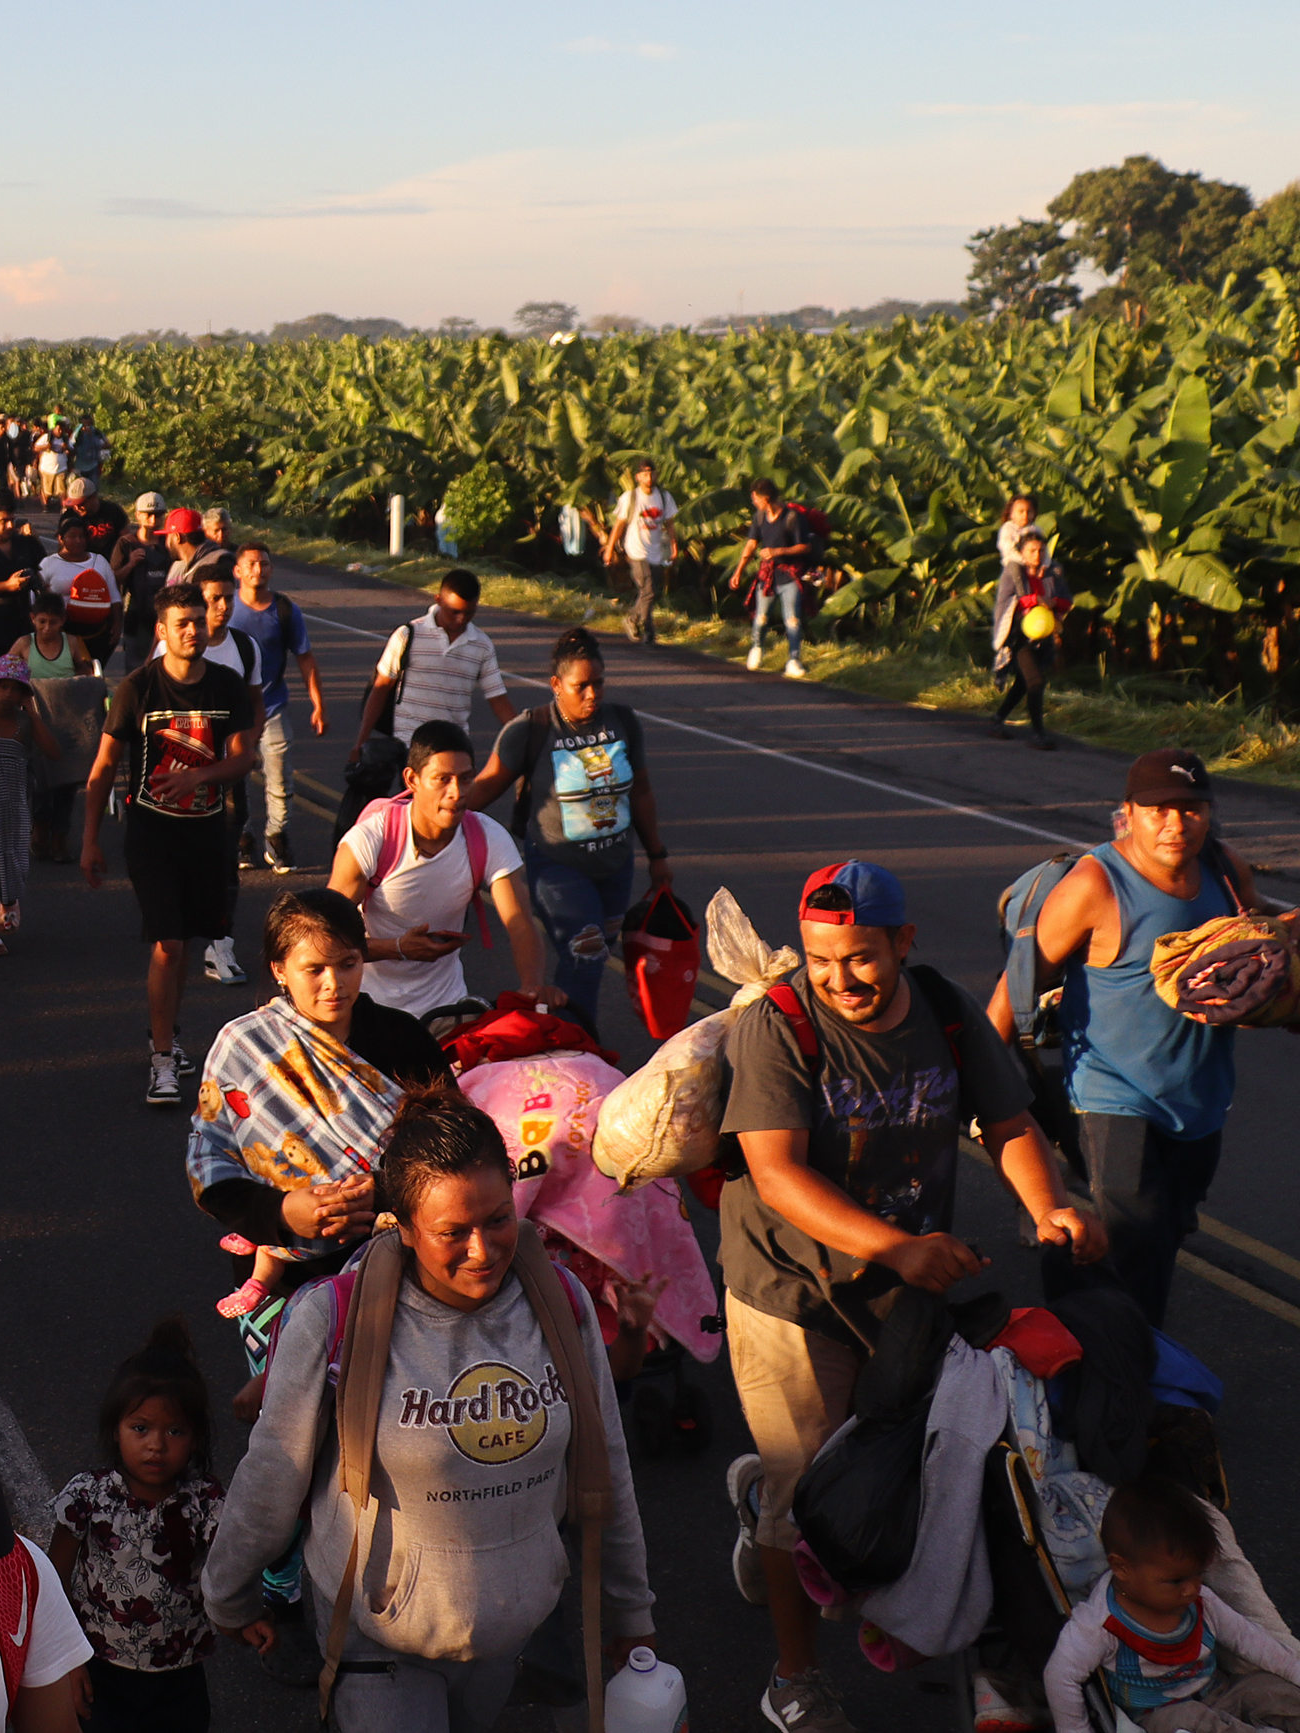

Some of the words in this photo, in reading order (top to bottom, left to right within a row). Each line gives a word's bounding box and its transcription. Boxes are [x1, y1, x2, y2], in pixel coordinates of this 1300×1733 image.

[554, 730, 616, 748] MONDAY
[596, 787, 611, 795] VS
[399, 1381, 492, 1428] Hard
[495, 1363, 568, 1424] Rock
[478, 1430, 526, 1449] CAFE
[426, 1481, 523, 1502] NORTHFIELD
[526, 1466, 557, 1490] PARK
